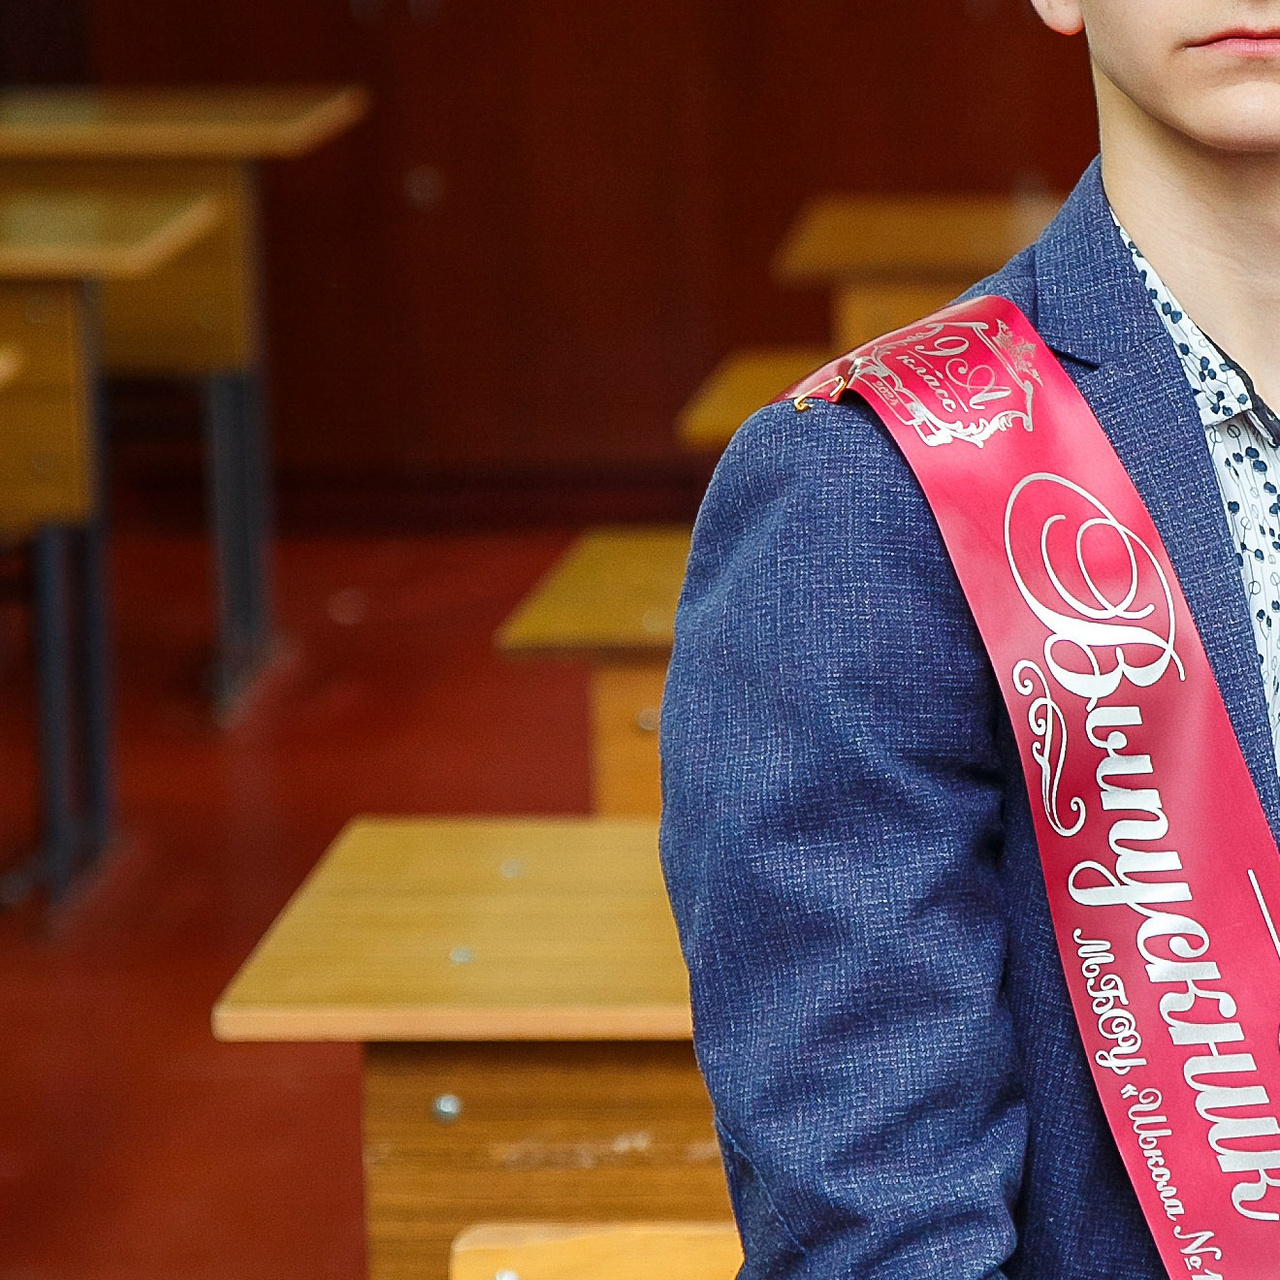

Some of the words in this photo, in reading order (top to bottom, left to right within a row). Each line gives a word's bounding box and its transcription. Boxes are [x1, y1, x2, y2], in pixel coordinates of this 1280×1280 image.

[871, 380, 900, 408] 2024
[895, 354, 957, 413] класс
[1072, 927, 1148, 1076] МБОУ
